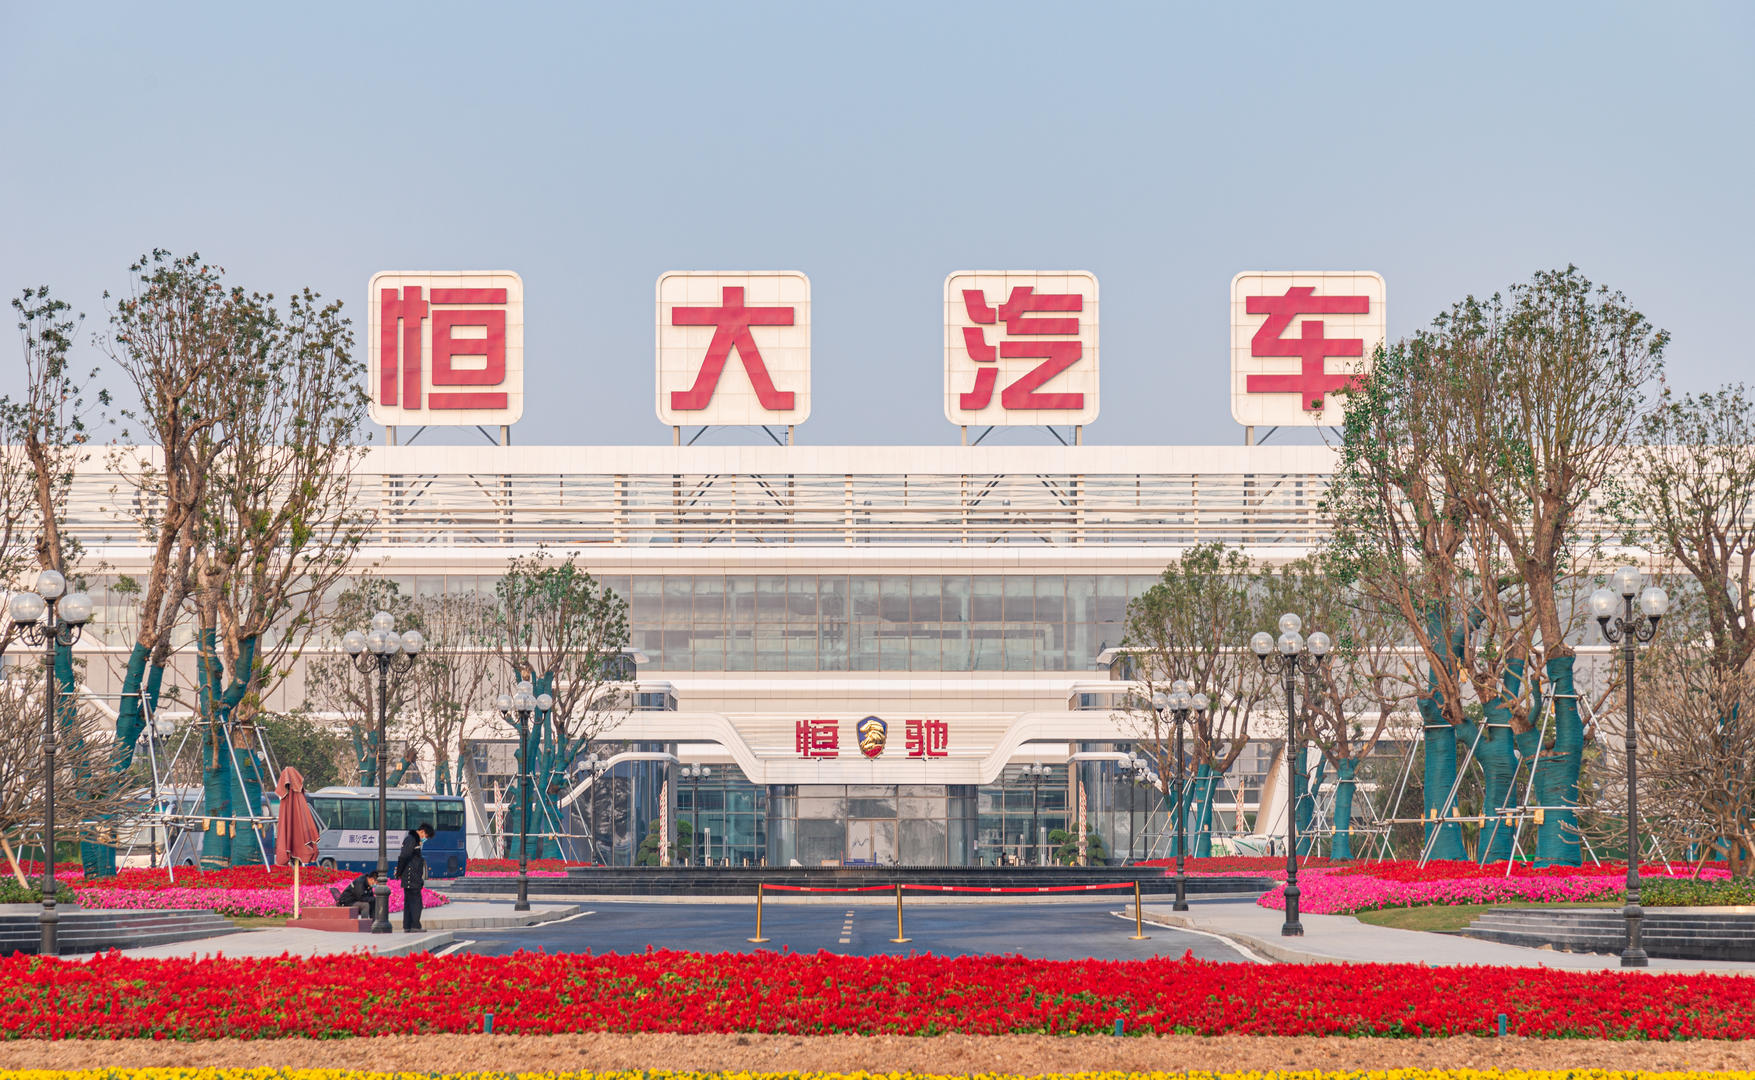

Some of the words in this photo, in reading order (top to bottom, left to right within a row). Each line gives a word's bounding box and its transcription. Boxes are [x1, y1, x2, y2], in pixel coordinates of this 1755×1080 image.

[380, 286, 1372, 410] 恒大汽车
[795, 719, 948, 757] 恒驰
